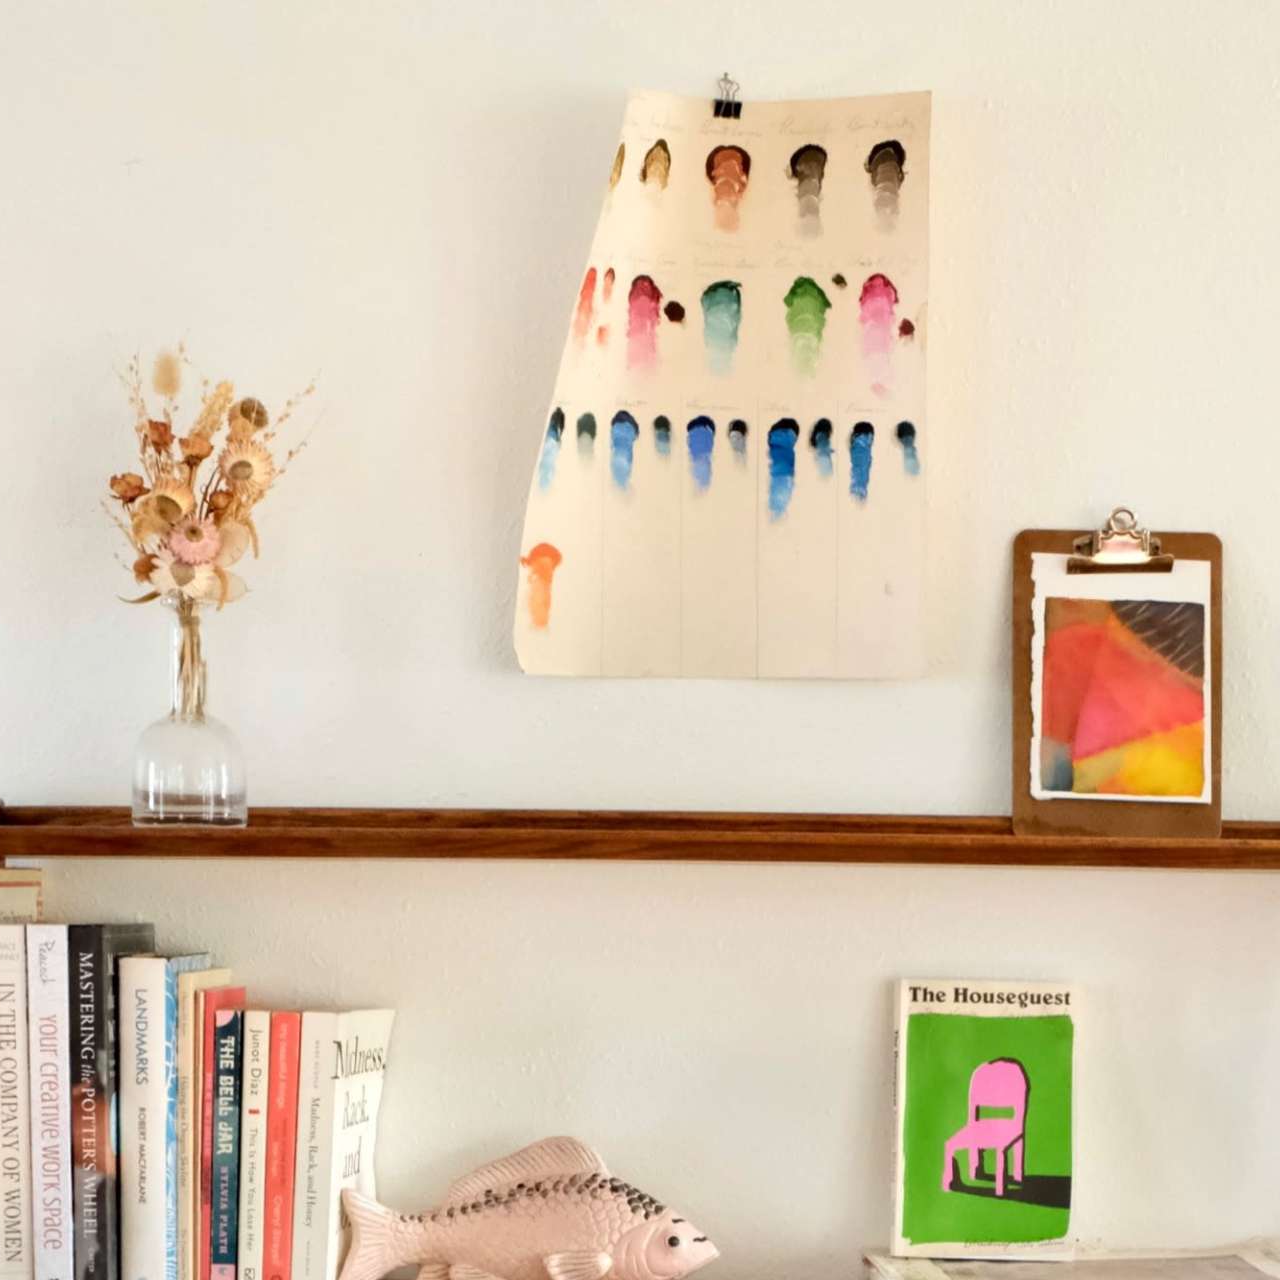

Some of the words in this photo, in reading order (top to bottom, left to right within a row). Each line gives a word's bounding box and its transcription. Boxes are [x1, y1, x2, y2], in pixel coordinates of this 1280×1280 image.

[78, 951, 96, 1060] MASTERING
[908, 986, 947, 1004] The
[952, 986, 1072, 1009] Houseguest
[134, 988, 150, 1087] LANDMARKS
[218, 1035, 236, 1069] THE
[249, 1029, 264, 1063] Junot
[80, 1063, 95, 1083] the
[0, 1057, 20, 1152] COMPANY
[218, 1075, 236, 1116] BELL
[80, 1087, 98, 1172] POTTER'S
[138, 1106, 148, 1142] ROBERT
[249, 1128, 260, 1147] This
[307, 1096, 322, 1143] Madness,
[216, 1121, 235, 1155] JAR
[2, 1156, 22, 1184] OF
[306, 1145, 320, 1174] Rack,
[219, 1165, 230, 1210] SYLVIA
[305, 1174, 318, 1194] and
[82, 1174, 98, 1240] WHEEL
[303, 1195, 318, 1228] Honey
[3, 1188, 24, 1263] WOMEN
[218, 1214, 230, 1255] PLATH
